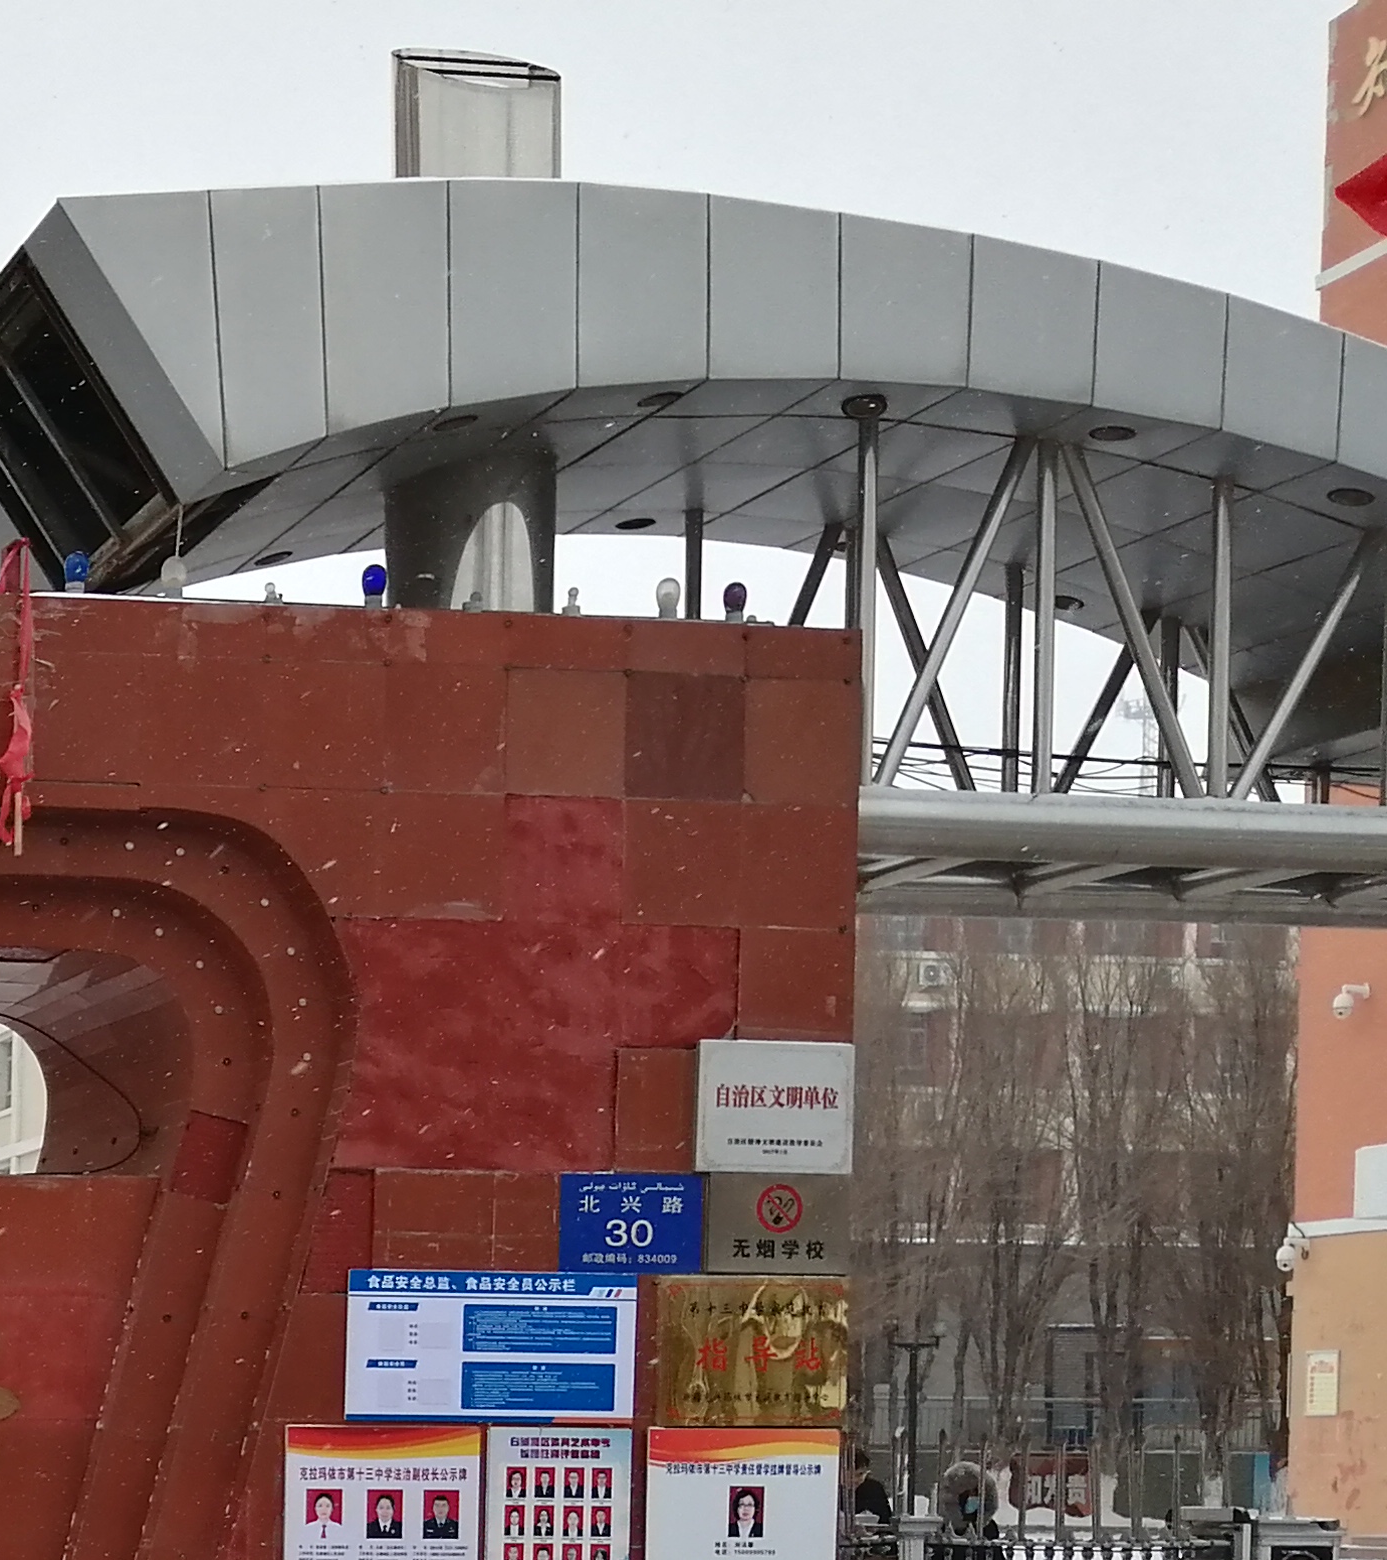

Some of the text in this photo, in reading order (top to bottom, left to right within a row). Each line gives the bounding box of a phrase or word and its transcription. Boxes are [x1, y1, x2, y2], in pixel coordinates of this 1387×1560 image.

[715, 1083, 839, 1110] 自治区文明单位
[578, 1195, 684, 1215] 北兴路
[605, 1219, 654, 1248] 30
[732, 1239, 825, 1261] 无烟学校
[366, 1275, 577, 1293] 食品安全总监、食品安全员公示栏
[697, 1335, 821, 1373] 指导站
[299, 1466, 468, 1482] 克拉玛依市第十三中学法治副校长公示牌
